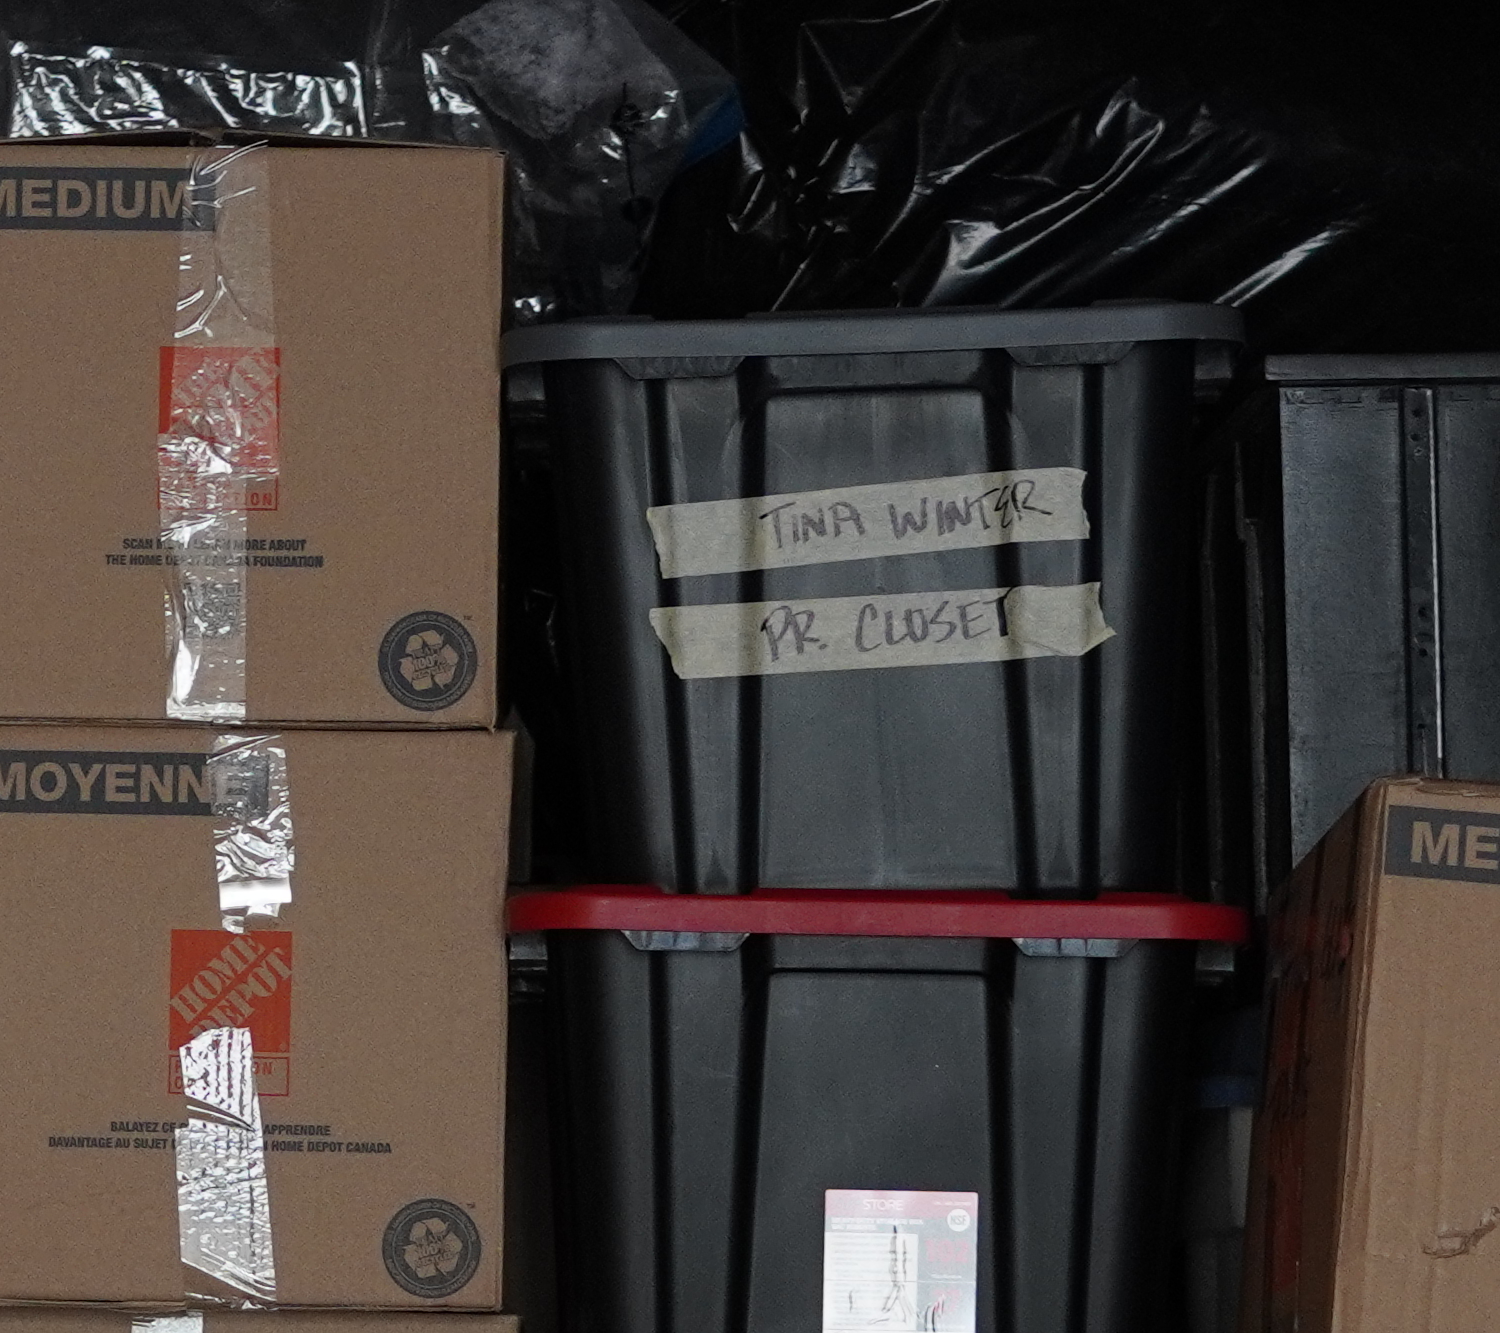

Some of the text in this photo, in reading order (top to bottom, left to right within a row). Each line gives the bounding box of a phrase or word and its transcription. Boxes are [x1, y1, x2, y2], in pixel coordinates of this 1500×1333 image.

[759, 479, 1053, 549] TINA WINTER
[270, 539, 306, 552] ABOUT
[106, 554, 127, 566] THE
[129, 554, 163, 566] HOME
[252, 555, 325, 568] FOUNDATION
[855, 585, 1019, 652] CLOSET
[169, 934, 266, 1024] HOME
[111, 1121, 161, 1133] BALAYEZ
[49, 1136, 392, 1155] DAVANTAGE AU SUJET HOME DEPOT CANADA
[862, 1199, 904, 1211] STORE
